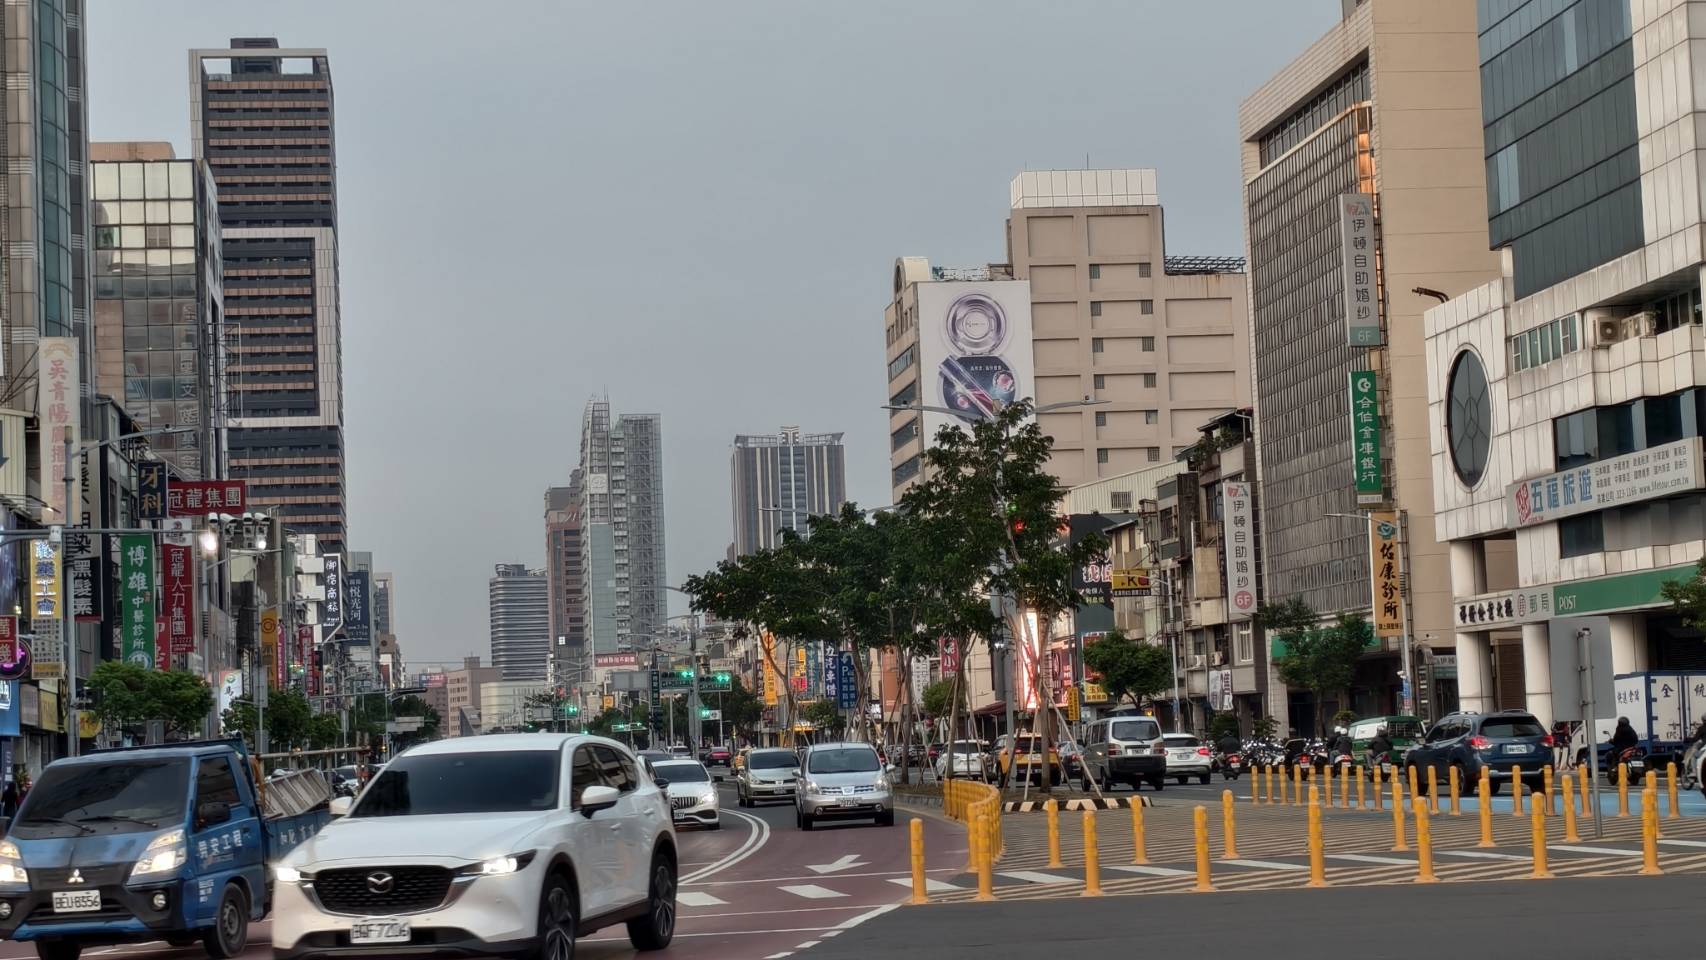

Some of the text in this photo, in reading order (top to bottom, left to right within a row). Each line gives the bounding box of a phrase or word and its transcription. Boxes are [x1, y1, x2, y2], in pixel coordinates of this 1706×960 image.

[1358, 330, 1372, 342] 6F
[141, 465, 164, 515] 牙科
[168, 486, 241, 510] 冠龍集團
[1531, 468, 1592, 512] 五福旅遊
[127, 545, 148, 649] 博雄中醫診所
[169, 548, 186, 636] 冠龍人力集團
[1236, 594, 1251, 607] 6F
[1559, 595, 1577, 610] POST
